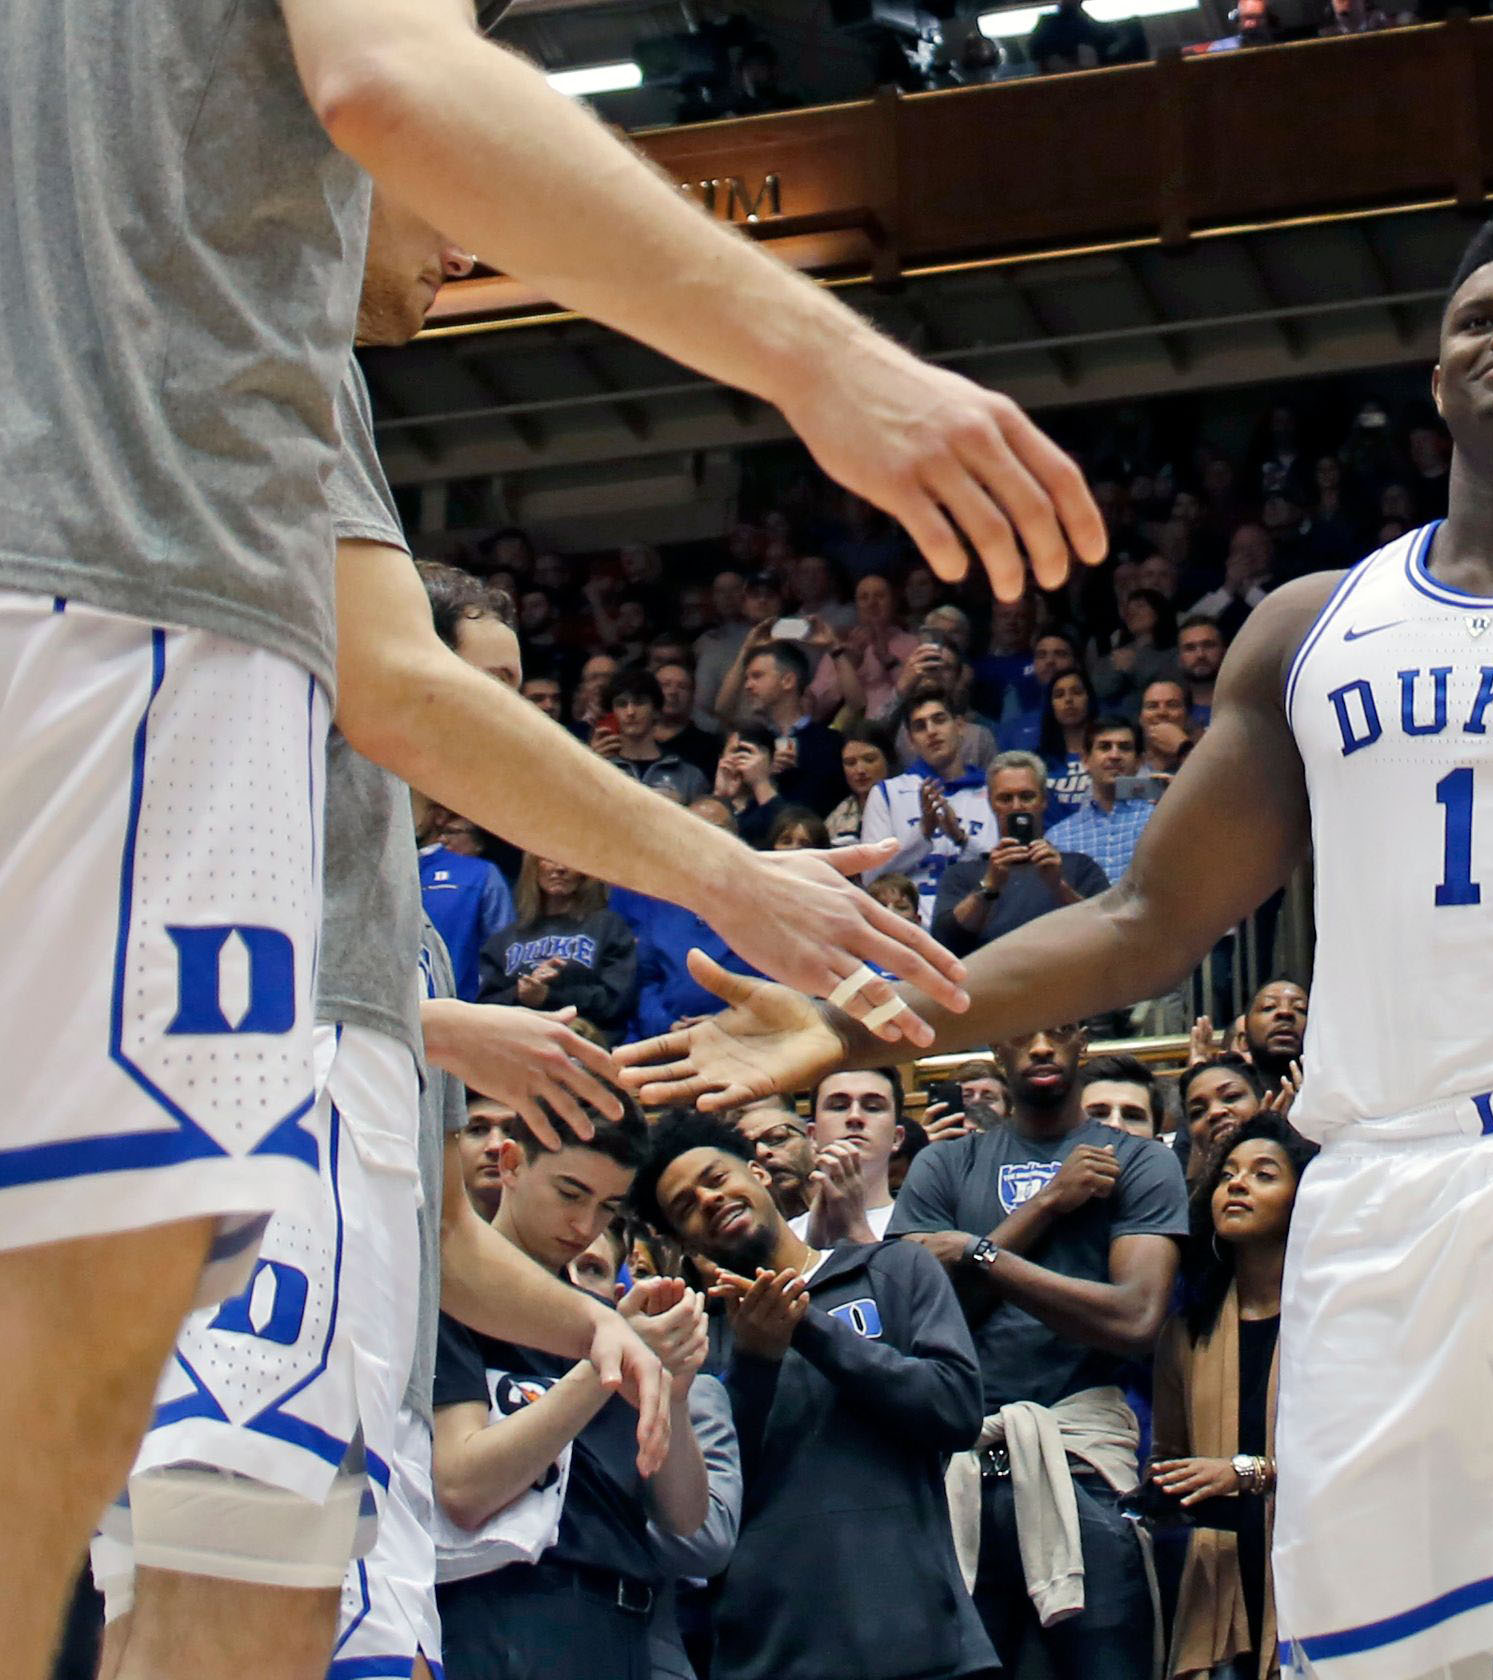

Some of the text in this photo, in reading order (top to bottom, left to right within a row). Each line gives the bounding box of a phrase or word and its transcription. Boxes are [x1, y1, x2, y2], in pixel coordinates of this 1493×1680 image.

[1435, 767, 1481, 906] 1
[164, 925, 296, 1036] D
[505, 934, 597, 977] DUKE
